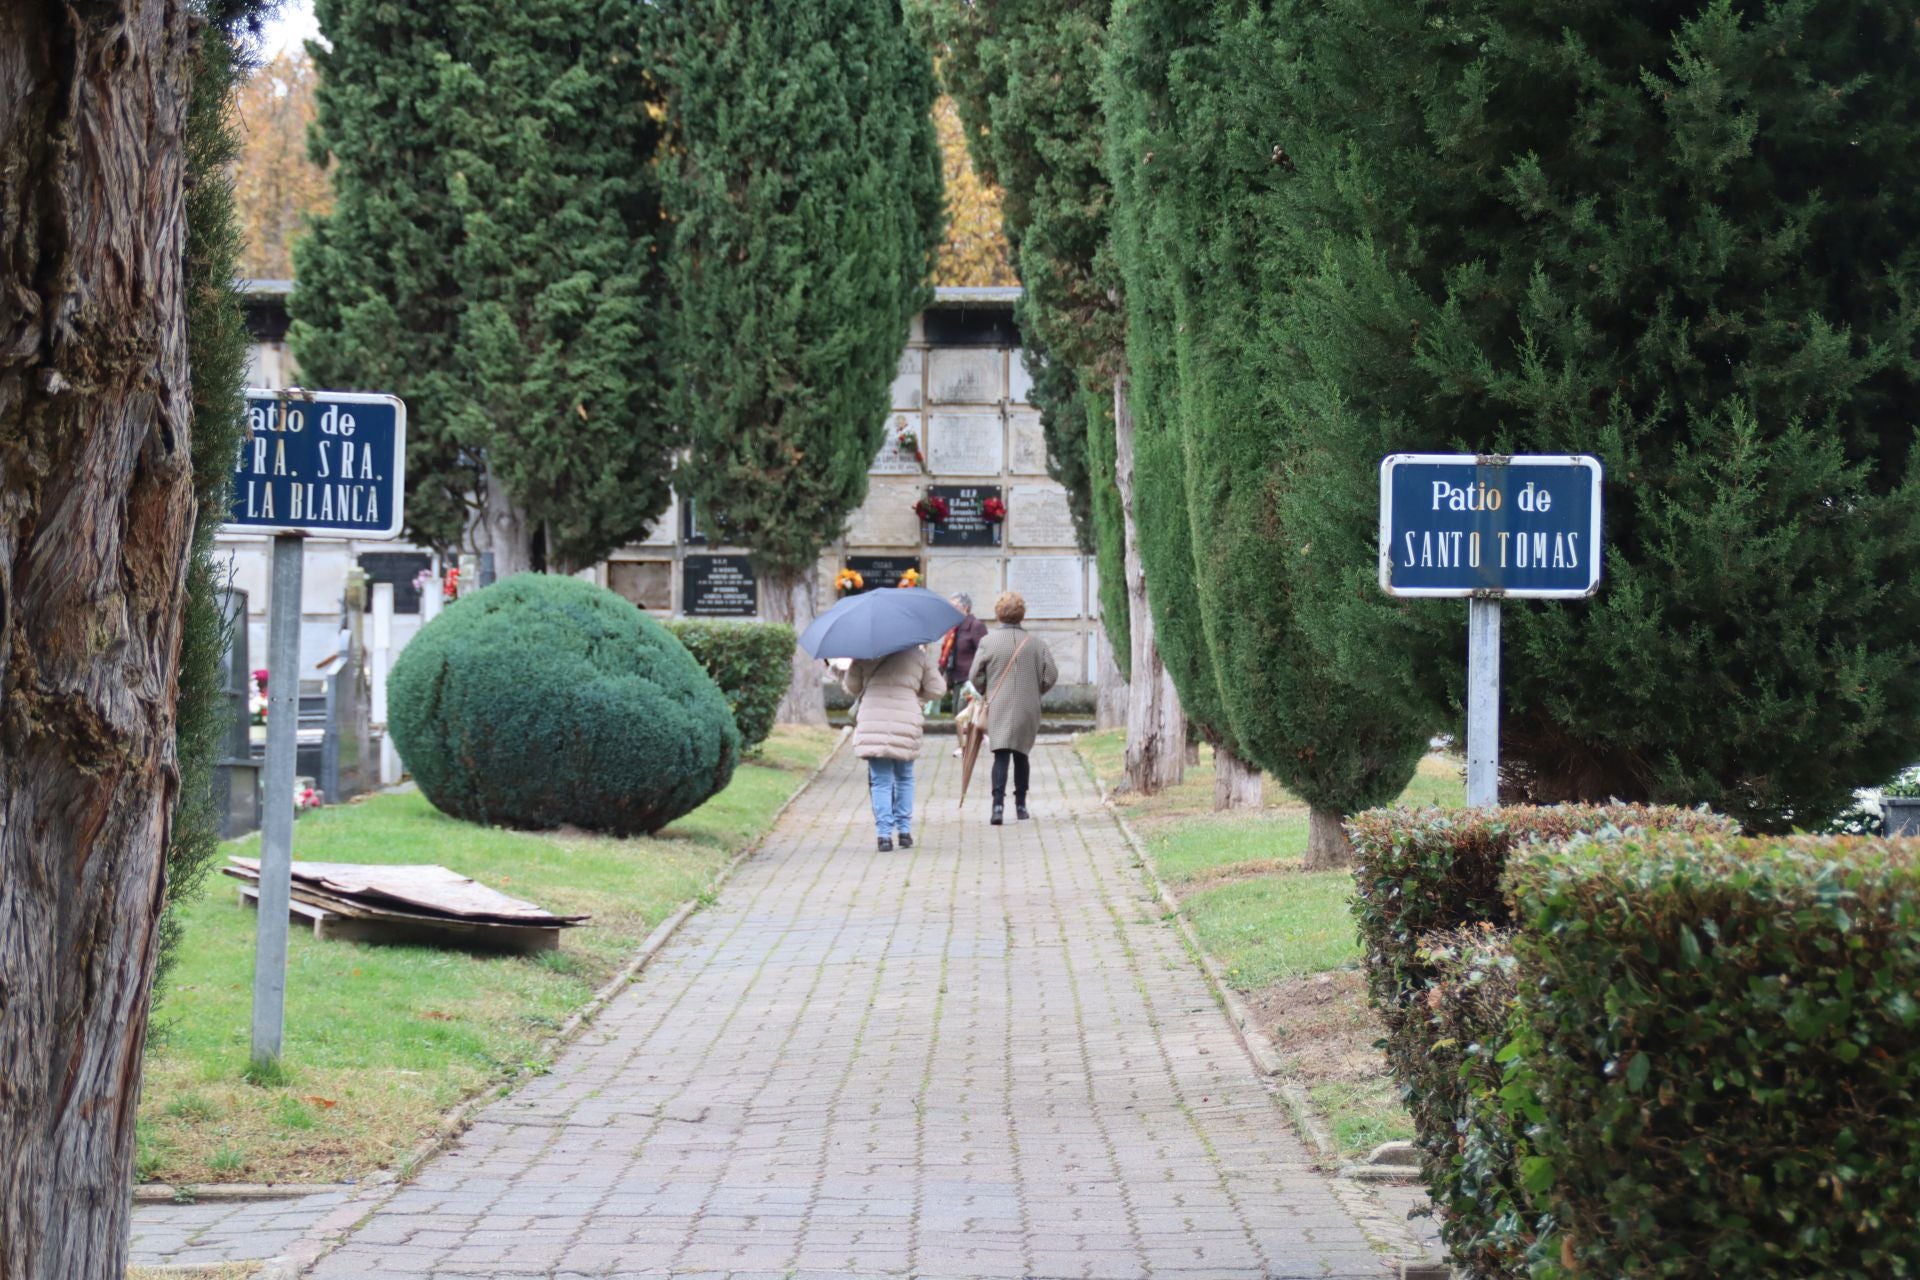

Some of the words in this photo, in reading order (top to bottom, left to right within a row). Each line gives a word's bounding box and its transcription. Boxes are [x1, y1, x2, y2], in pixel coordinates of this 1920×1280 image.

[244, 400, 305, 433] atio
[321, 404, 356, 436] de
[317, 440, 383, 480] SRA.
[247, 480, 275, 519] LA
[290, 482, 379, 523] BLANCA
[1432, 481, 1502, 511] Patio
[1517, 482, 1552, 512] de
[1404, 531, 1481, 568] SANTO
[1498, 532, 1578, 568] TOMAS
